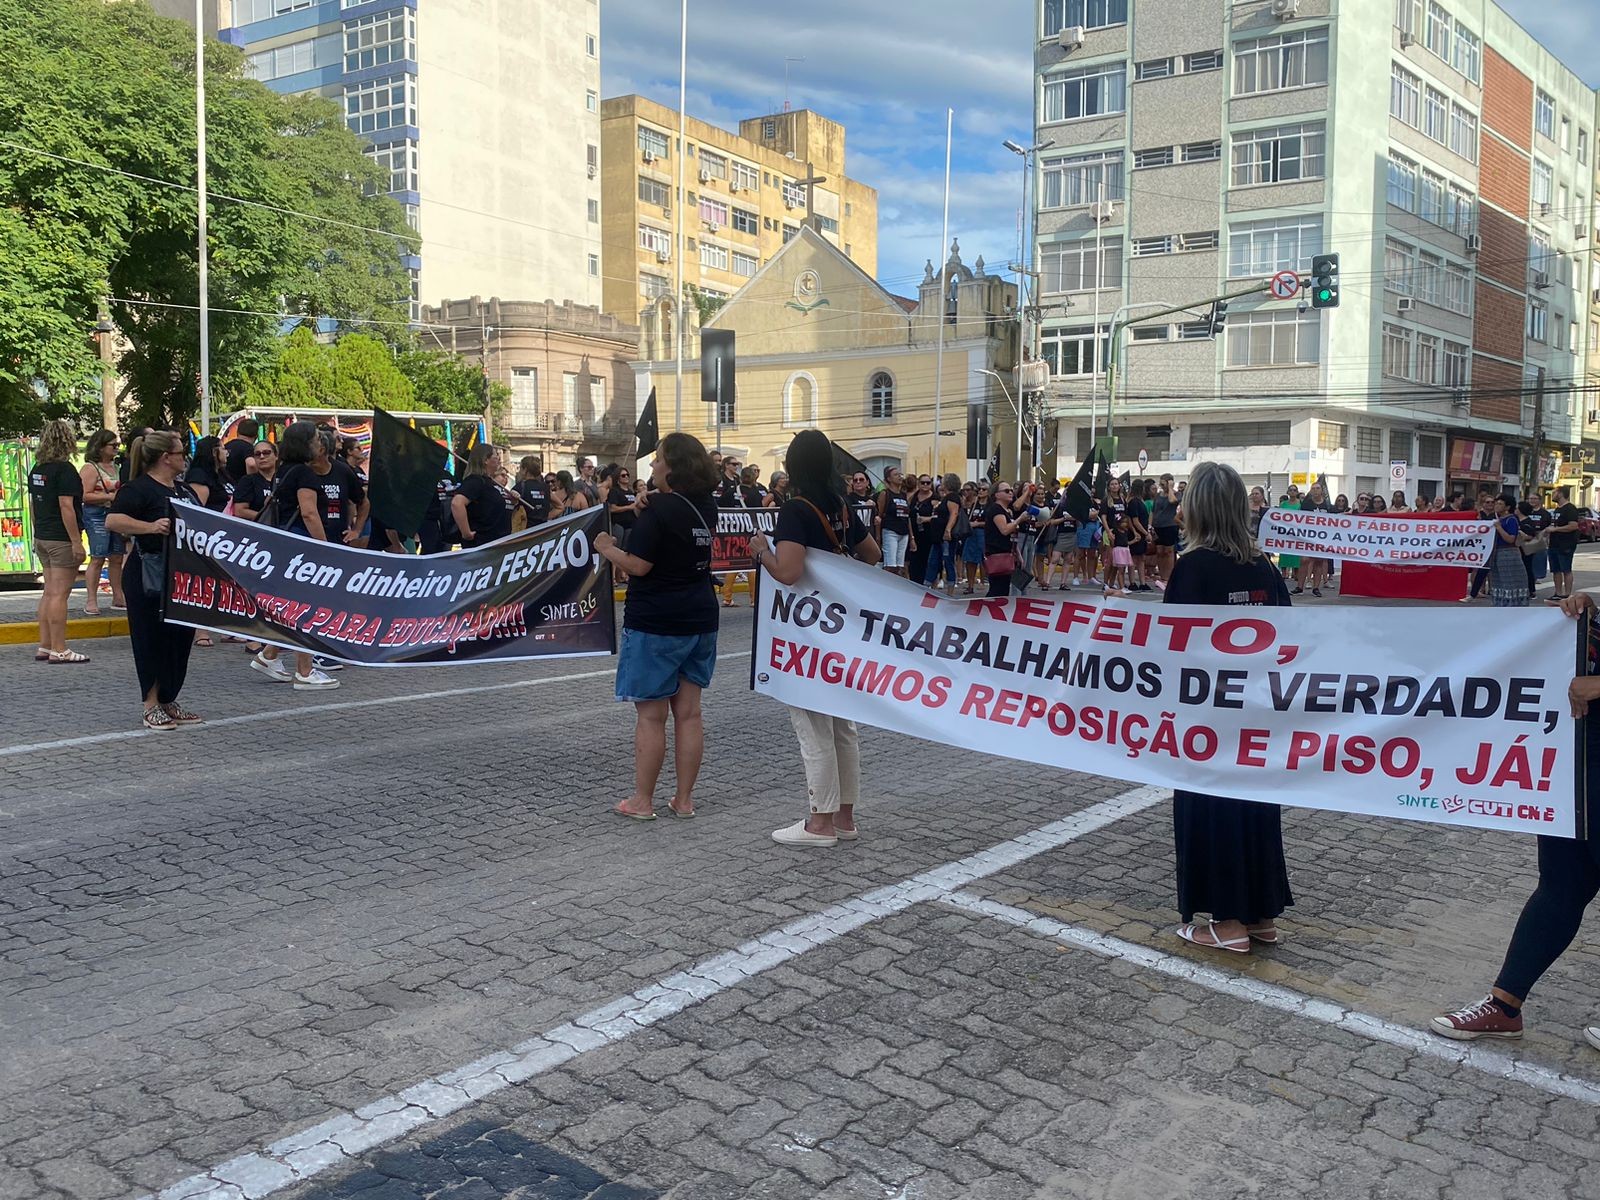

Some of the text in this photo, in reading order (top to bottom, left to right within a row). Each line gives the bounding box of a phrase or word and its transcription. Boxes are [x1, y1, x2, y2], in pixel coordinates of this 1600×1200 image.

[756, 512, 773, 532] DO
[1270, 511, 1491, 534] GOVERNO FÁBIO BRANCO
[1265, 538, 1484, 564] ENTERRANDO A EDUCAÇÃO!
[1332, 532, 1342, 541] A
[1347, 533, 1395, 546] VOLTA
[1400, 537, 1431, 547] POR
[175, 518, 600, 603] Prefeito, tem dinheiro pra FESTÃO,
[171, 570, 216, 610] MAS
[255, 592, 308, 630] TEM
[302, 602, 382, 647] PARA
[540, 602, 578, 621] SINTE
[770, 588, 1560, 735] NÓS TRABALHAMOS DE VERDADE,
[769, 637, 1558, 793] EXIGIMOS REPOSIÇÃO E PISO, JÁ!
[1397, 794, 1439, 809] SINTE
[1469, 799, 1512, 818] CUT
